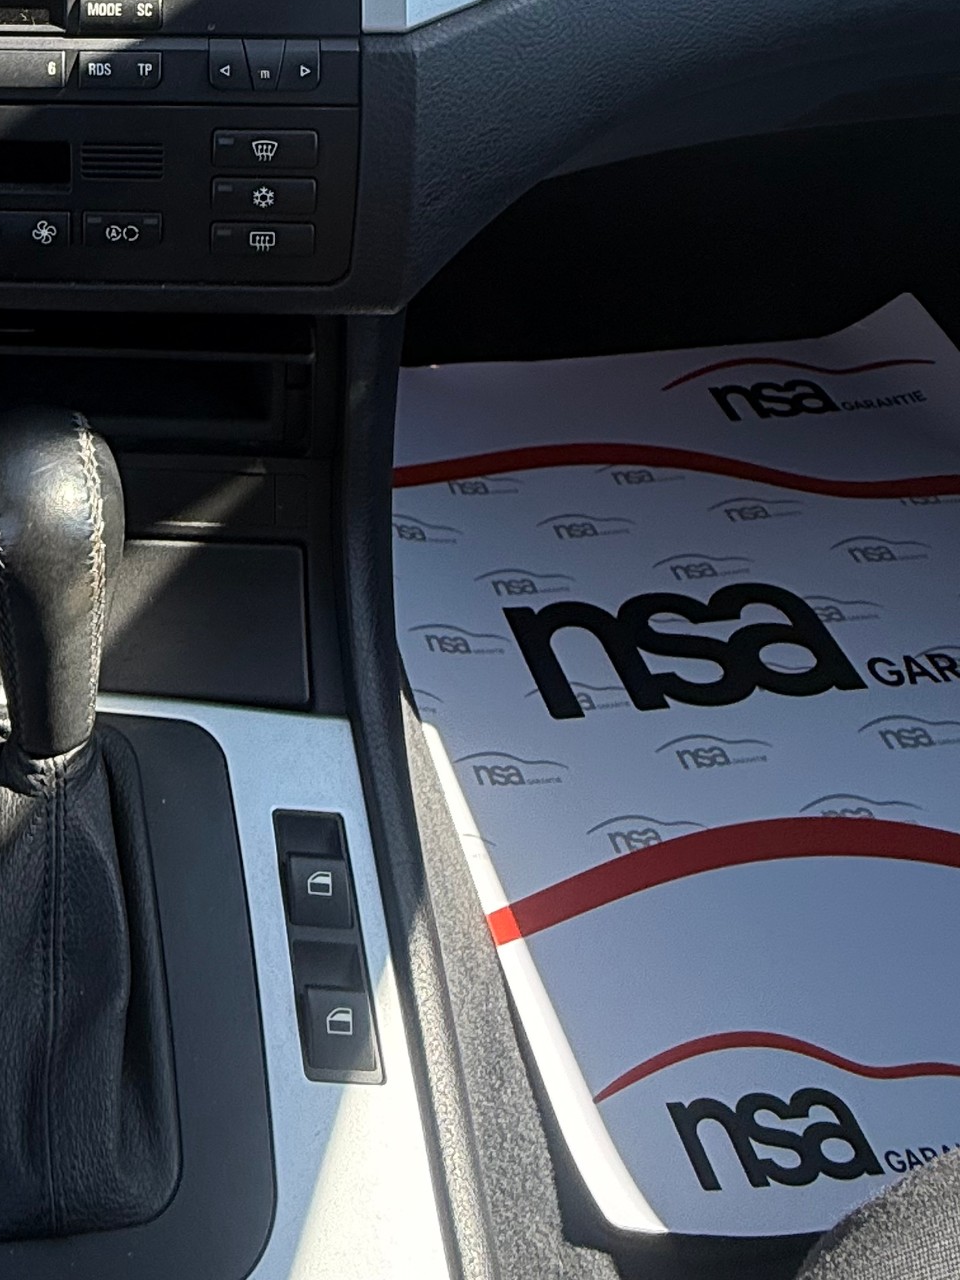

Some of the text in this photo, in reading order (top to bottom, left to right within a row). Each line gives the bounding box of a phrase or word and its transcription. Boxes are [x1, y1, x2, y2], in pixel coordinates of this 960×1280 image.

[87, 1, 153, 18] MODE SC
[47, 62, 57, 76] 6
[87, 63, 153, 77] RDS TP
[260, 68, 270, 80] m
[708, 379, 927, 422] nsa GARANTIE
[553, 522, 600, 540] nsa
[492, 578, 539, 597] nsa
[424, 634, 472, 654] nsa
[502, 582, 869, 720] nsa
[879, 726, 936, 751] nsa
[676, 745, 732, 771] nsa
[472, 764, 525, 787] nsa
[665, 1087, 886, 1192] nsa
